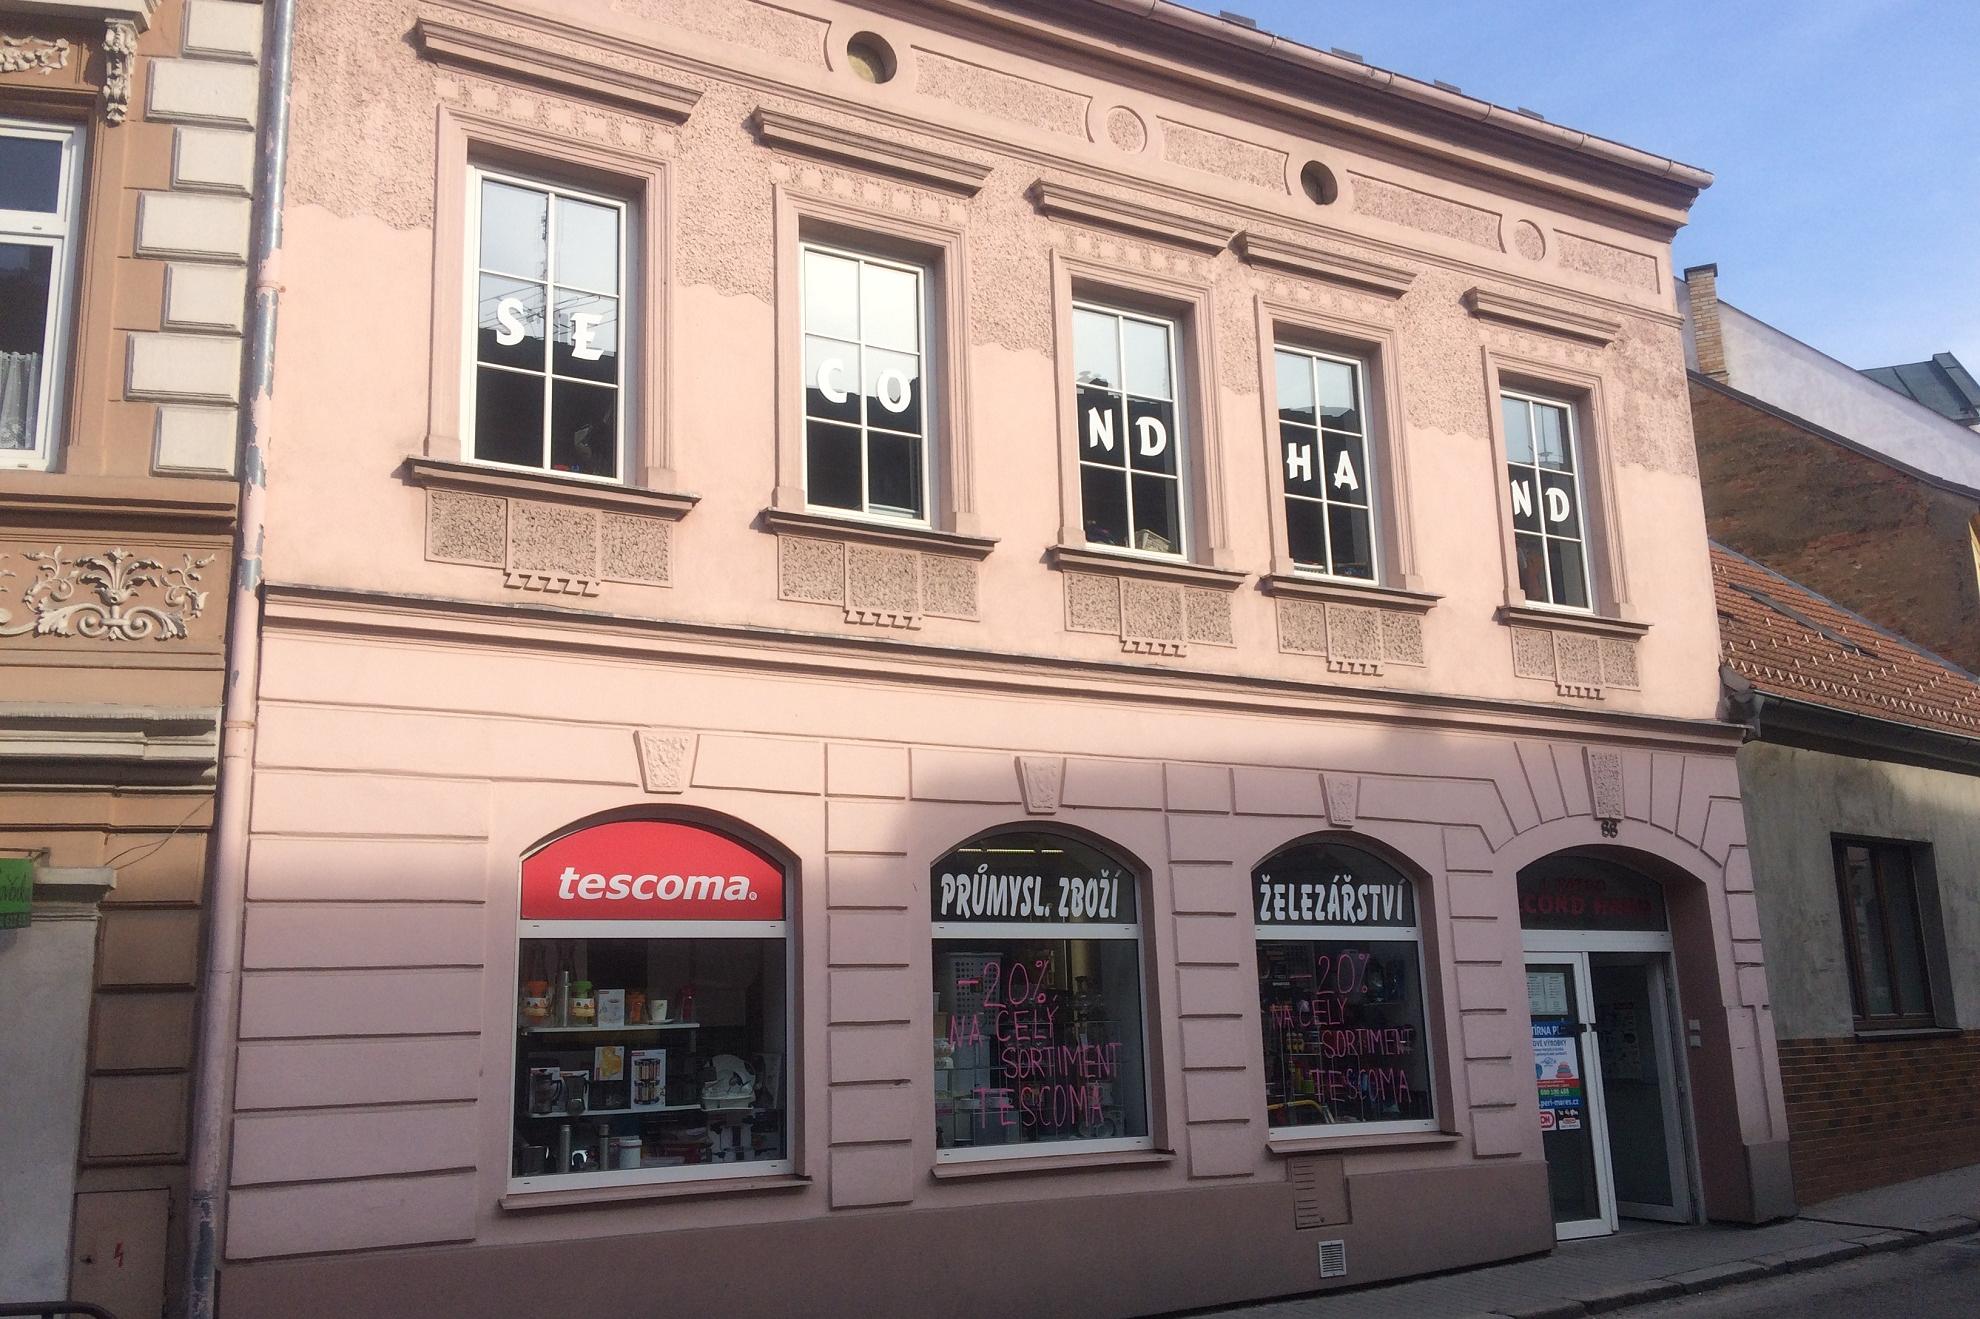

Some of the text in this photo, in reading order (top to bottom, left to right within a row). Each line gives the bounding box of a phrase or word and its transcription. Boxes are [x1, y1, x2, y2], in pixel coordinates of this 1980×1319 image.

[941, 863, 1122, 919] PRŮMYSL. ZBOŽÍ
[1260, 874, 1405, 923] ŽELEZÁŘSTVÍ
[957, 960, 1049, 1008] -20%
[1288, 953, 1370, 995] -20%
[950, 1013, 983, 1048] NA
[1271, 1003, 1295, 1031] NA
[1001, 1042, 1122, 1079] SORTIMENT
[1321, 1028, 1413, 1059] SORTIMENT
[1309, 1067, 1411, 1104] TESCOMA
[972, 1084, 1104, 1129] TESCOMA
